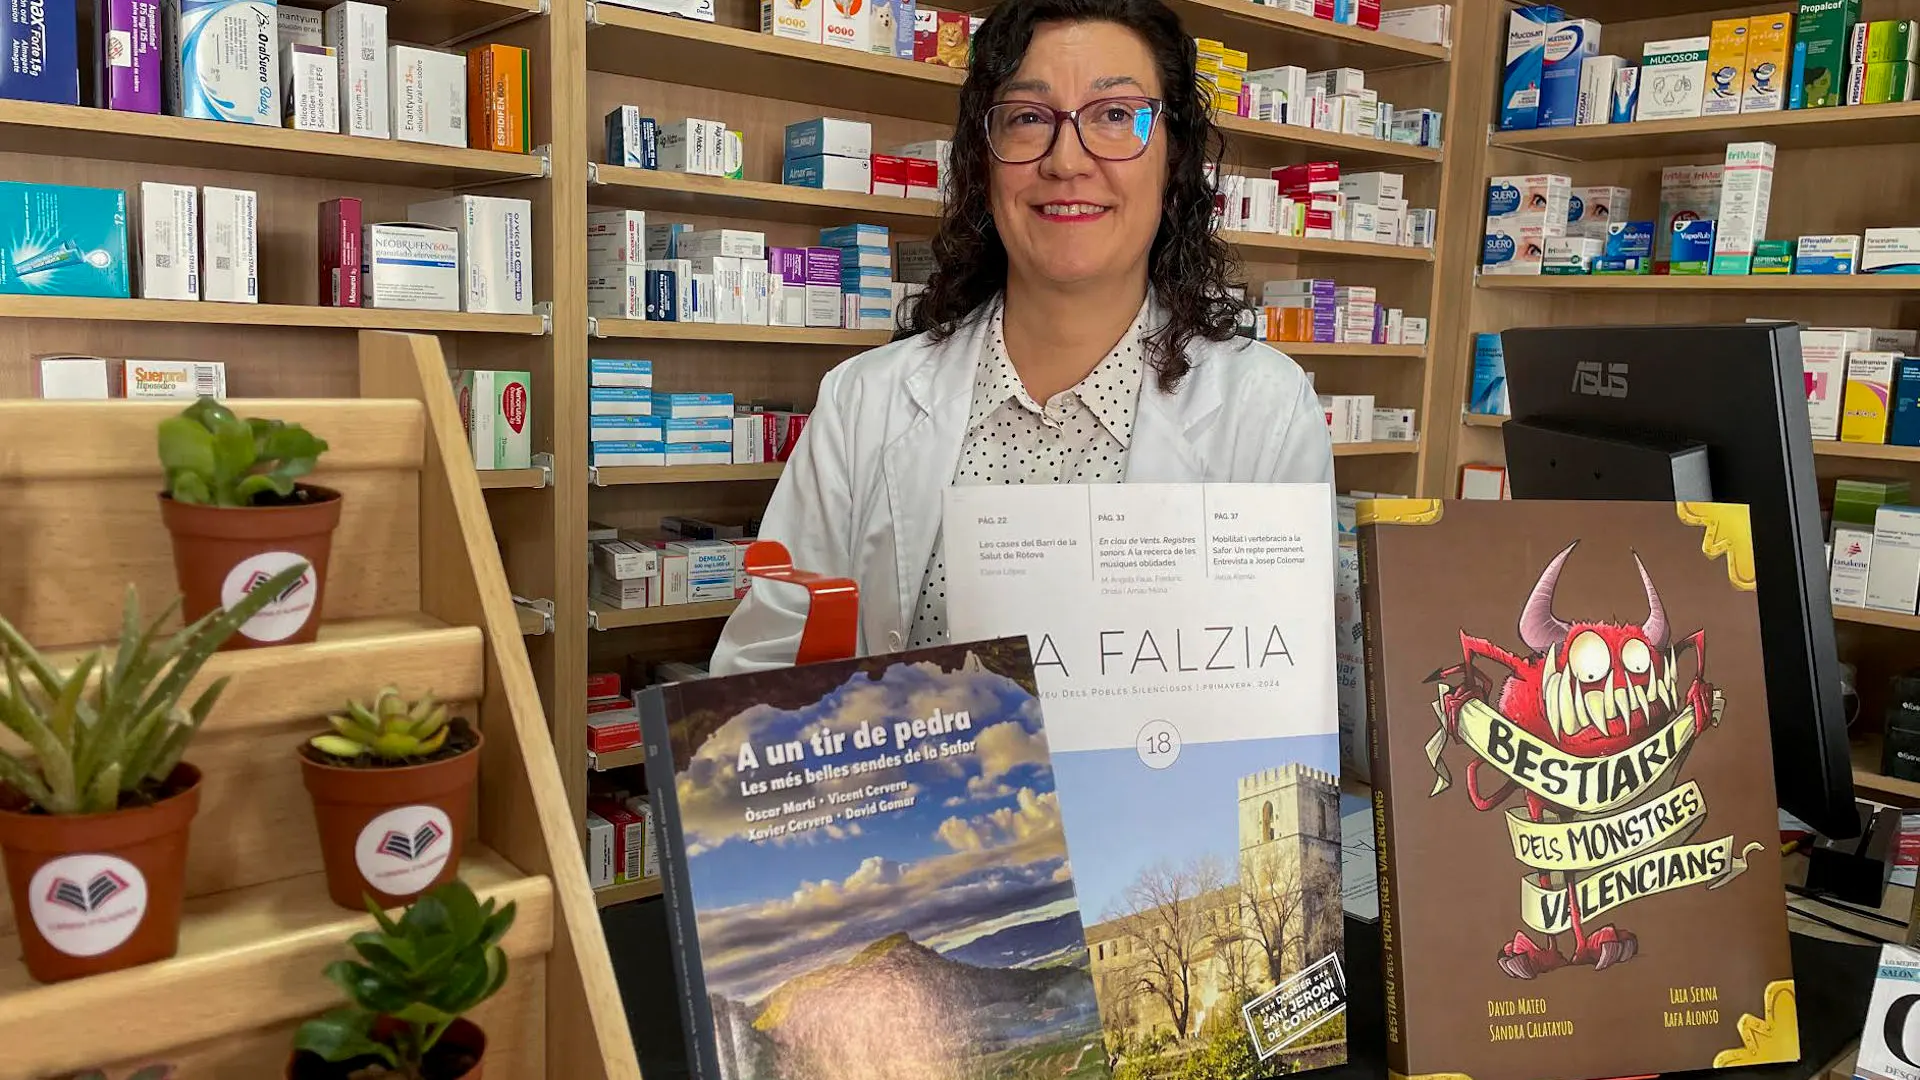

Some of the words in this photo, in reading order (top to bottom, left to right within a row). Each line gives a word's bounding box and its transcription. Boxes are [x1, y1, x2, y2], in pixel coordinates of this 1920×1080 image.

[20, 8, 28, 24] oral
[277, 12, 319, 24] nantyum
[31, 29, 42, 57] Forte
[11, 38, 20, 73] Almagate
[20, 39, 29, 74] Almagato
[1649, 52, 1699, 65] MUCOSOR
[415, 60, 424, 79] sobre
[258, 86, 273, 117] Baby
[404, 86, 417, 131] Enantyum
[416, 90, 424, 104] oral
[354, 94, 364, 130] Enantyum
[416, 105, 424, 132] solución
[496, 97, 506, 147] ESPIDIFEN
[1491, 189, 1518, 200] SUERO
[114, 213, 124, 225] 12
[1487, 239, 1512, 249] SUERO
[348, 275, 357, 303] Monurol
[1571, 361, 1629, 398] ASUS
[997, 516, 1008, 525] 22
[1115, 514, 1125, 522] 33
[1230, 512, 1239, 520] 37
[979, 540, 994, 549] Les
[996, 541, 1020, 549] cases
[1020, 538, 1035, 548] del
[1036, 539, 1056, 547] Barri
[1057, 538, 1068, 547] de
[1069, 537, 1077, 546] la
[1099, 537, 1109, 546] En
[1110, 537, 1127, 546] clau
[1128, 537, 1138, 546] de
[1162, 536, 1196, 546] Registres
[1212, 535, 1244, 543] Mobilitat
[1234, 546, 1245, 554] Un
[1246, 547, 1265, 555] repte
[980, 551, 1001, 561] Salut
[1003, 551, 1014, 560] de
[1135, 548, 1142, 556] la
[1144, 548, 1172, 556] recerca
[1173, 547, 1184, 556] de
[1184, 547, 1196, 555] les
[1213, 557, 1248, 566] Entrevista
[1255, 557, 1275, 566] Josep
[1833, 557, 1868, 569] tanakene
[1099, 624, 1295, 675] FALZIA
[1259, 680, 1280, 688] 2024
[737, 742, 759, 772] A
[766, 737, 804, 766] un
[810, 727, 846, 757] tir
[853, 719, 888, 751] de
[894, 707, 972, 750] pedra
[1147, 731, 1171, 754] 18
[740, 780, 767, 797] Les
[770, 769, 803, 791] més
[805, 763, 850, 784] belles
[852, 752, 901, 776] sendes
[904, 748, 921, 764] de
[922, 746, 938, 761] la
[940, 738, 976, 757] Safor
[1487, 718, 1678, 804] BESTIARI
[745, 805, 781, 823] Òscar
[783, 796, 816, 816] Martí
[827, 787, 864, 806] Vicent
[865, 780, 909, 798] Cervera
[747, 822, 786, 843] Xavier
[788, 814, 833, 833] Cervera
[845, 805, 877, 820] David
[879, 795, 915, 812] Gomar
[1374, 789, 1389, 872] VALENCIANS
[1519, 832, 1564, 863] DELS
[1566, 787, 1700, 862] MONSTRES
[1540, 845, 1726, 929] VALENCIANS
[1379, 876, 1393, 951] MONSTRES
[1385, 954, 1395, 979] DELS
[1880, 967, 1914, 979] SALÓN
[1262, 1005, 1290, 1030] SANT
[1290, 976, 1336, 1013] JERONI
[1275, 977, 1313, 1006] DOSSIER
[1669, 987, 1689, 1005] LAIA
[1690, 985, 1718, 1003] SERNA
[1267, 1027, 1282, 1043] DE
[1282, 990, 1340, 1033] COTALBA
[1386, 982, 1399, 1044] BESTIARI
[1487, 999, 1516, 1018] DAVID
[1517, 997, 1546, 1016] MATEO
[1663, 1010, 1684, 1028] RAFA
[1685, 1008, 1719, 1027] ALONSO
[1488, 1022, 1525, 1042] SANDRA
[1526, 1018, 1574, 1040] CALATAYUD
